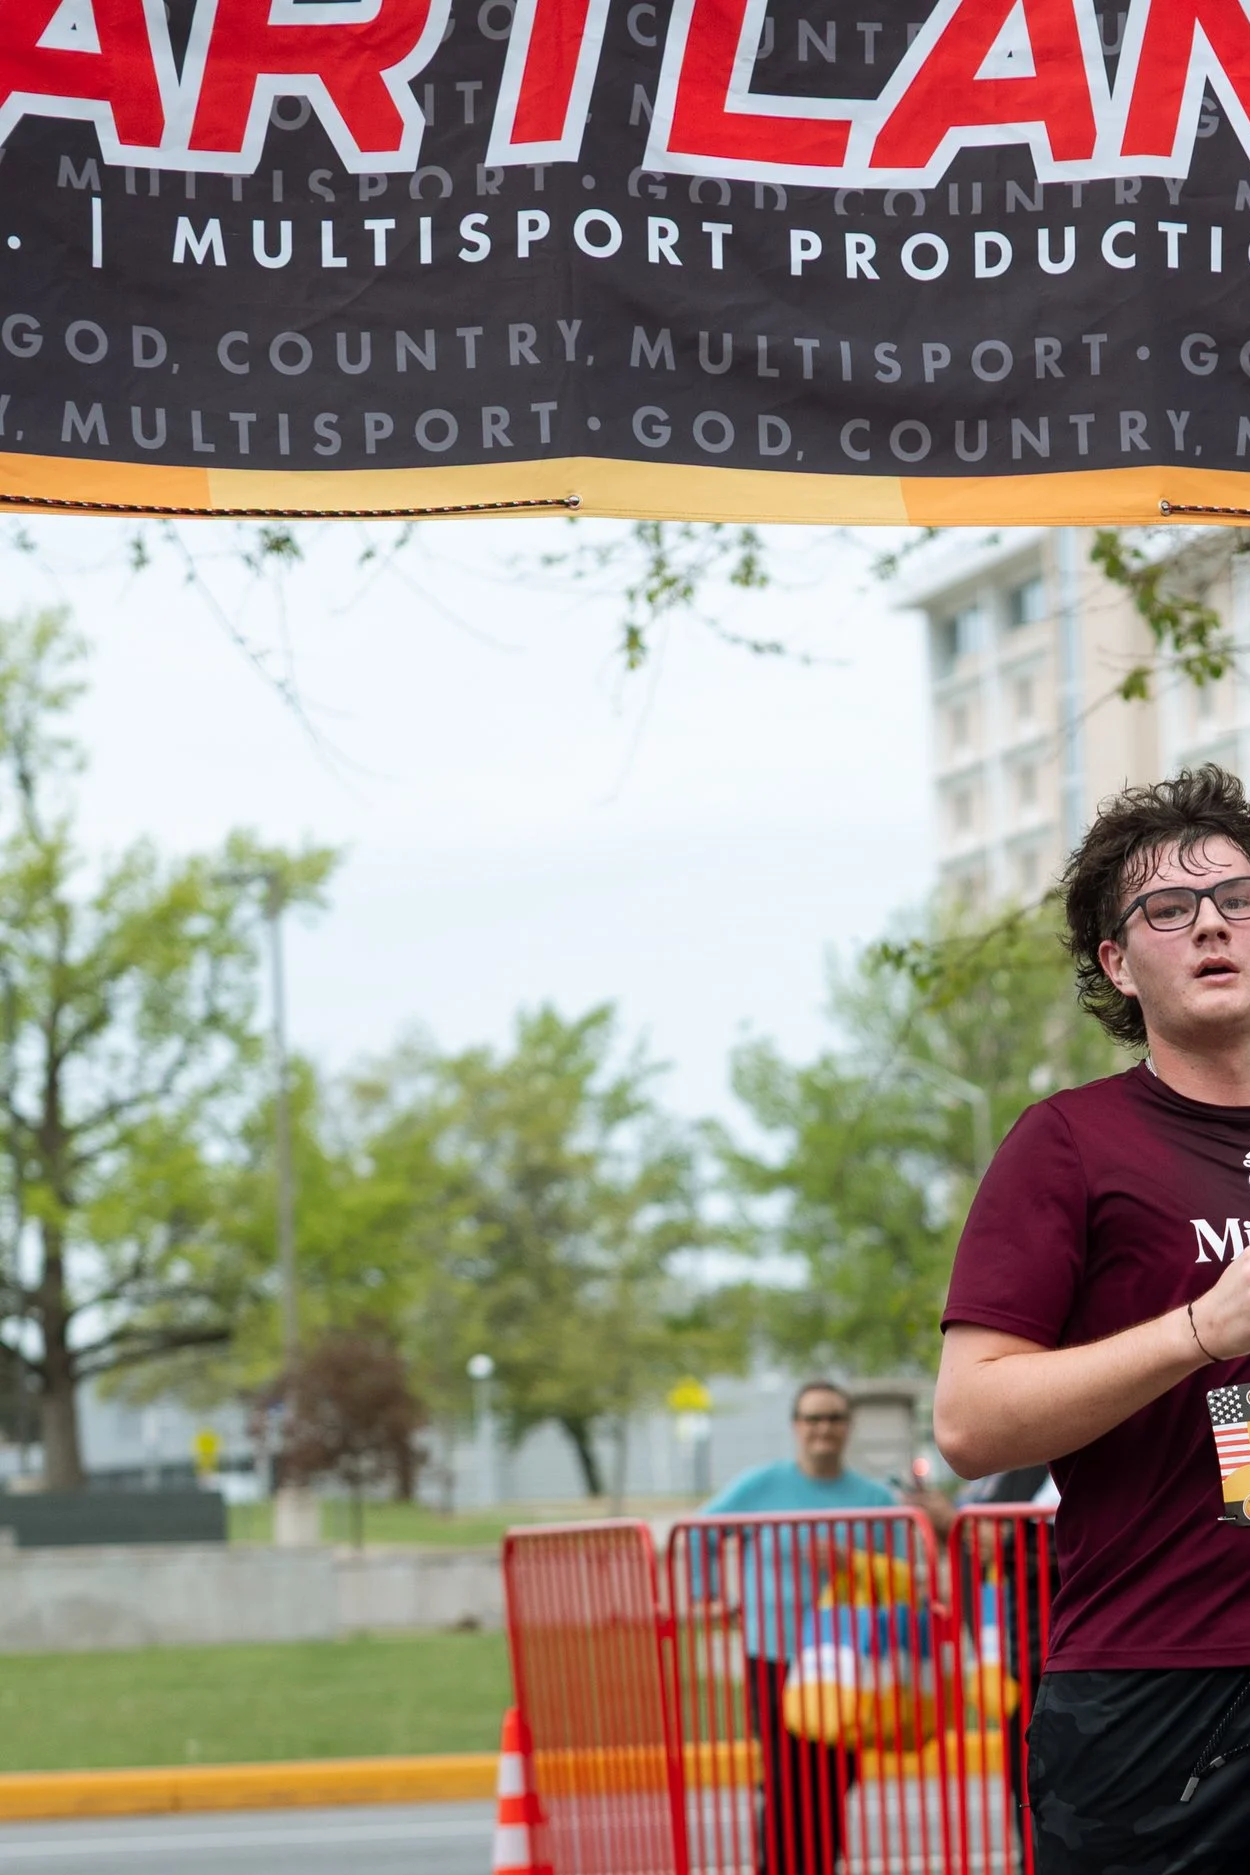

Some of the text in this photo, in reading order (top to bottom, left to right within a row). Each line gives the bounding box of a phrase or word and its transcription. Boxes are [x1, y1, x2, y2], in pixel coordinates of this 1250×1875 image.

[171, 208, 734, 270] MULTISPORT
[1, 314, 181, 375] GOD,
[216, 318, 596, 376] COUNTRY,
[629, 327, 1108, 384] MULTISPORT
[60, 400, 559, 456] MULTISPORT
[631, 405, 803, 462] GOD,
[839, 409, 1203, 463] COUNTRY,
